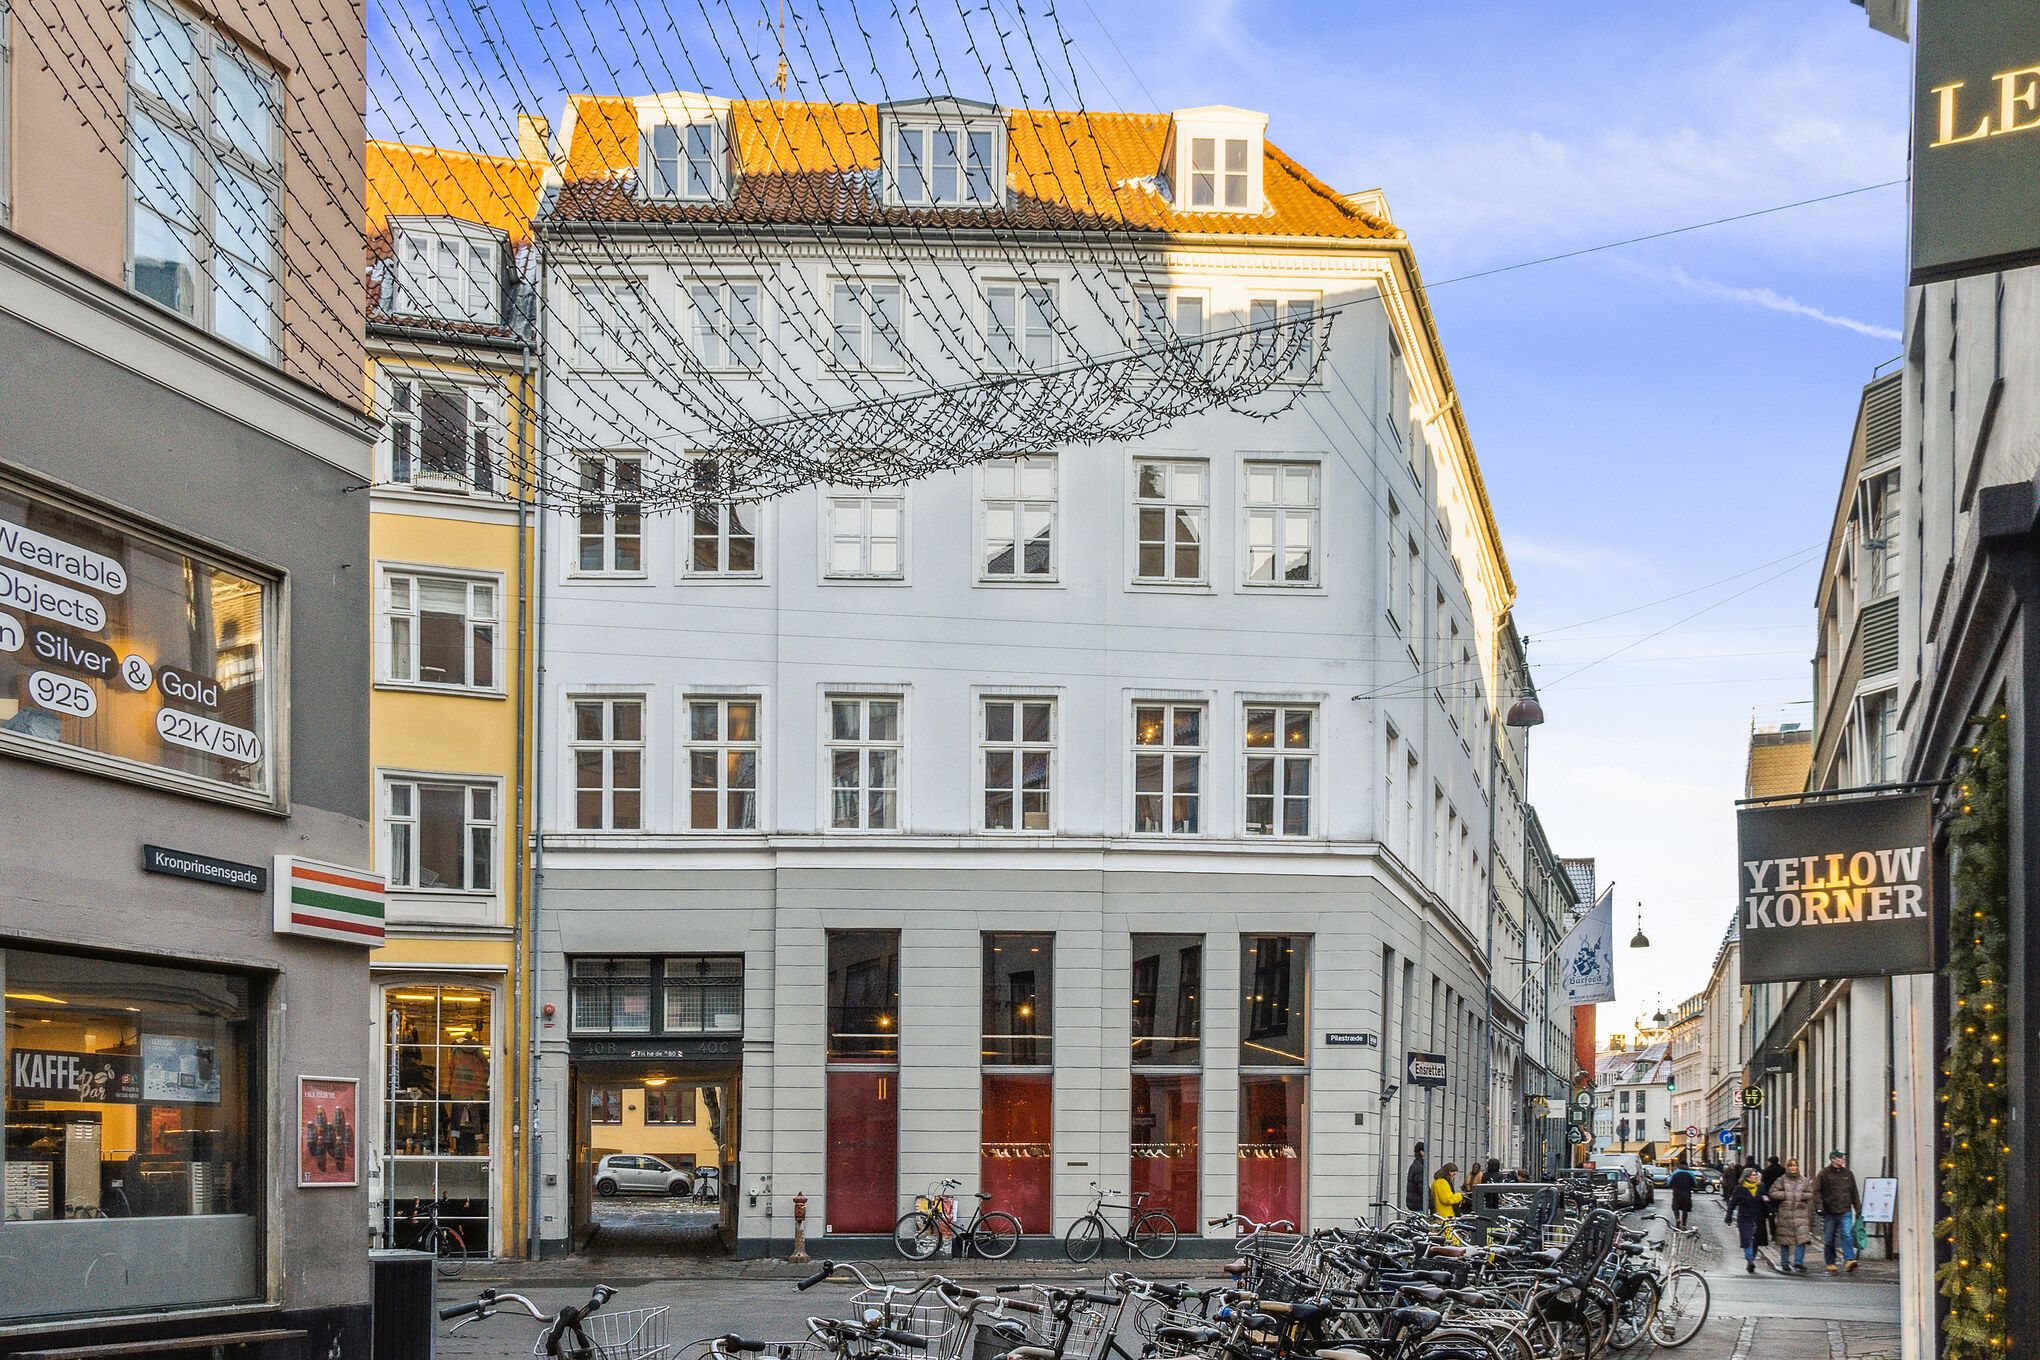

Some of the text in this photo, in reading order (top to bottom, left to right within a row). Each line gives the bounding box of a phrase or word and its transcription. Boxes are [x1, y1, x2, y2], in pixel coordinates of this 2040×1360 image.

[1929, 65, 2040, 149] LE
[0, 527, 122, 589] Wearable
[35, 630, 112, 673] Silver
[128, 660, 147, 687] &
[162, 671, 217, 708] Gold
[37, 678, 90, 712] 925
[163, 714, 257, 759] 22K/5M
[155, 852, 258, 884] Kronprinsensgade
[1743, 846, 1926, 894] YELLOW
[1745, 884, 1927, 930] KORNER
[1330, 1034, 1363, 1042] Pilestræde
[15, 1052, 80, 1090] KAFFE
[1415, 1063, 1445, 1076] Ensrettet
